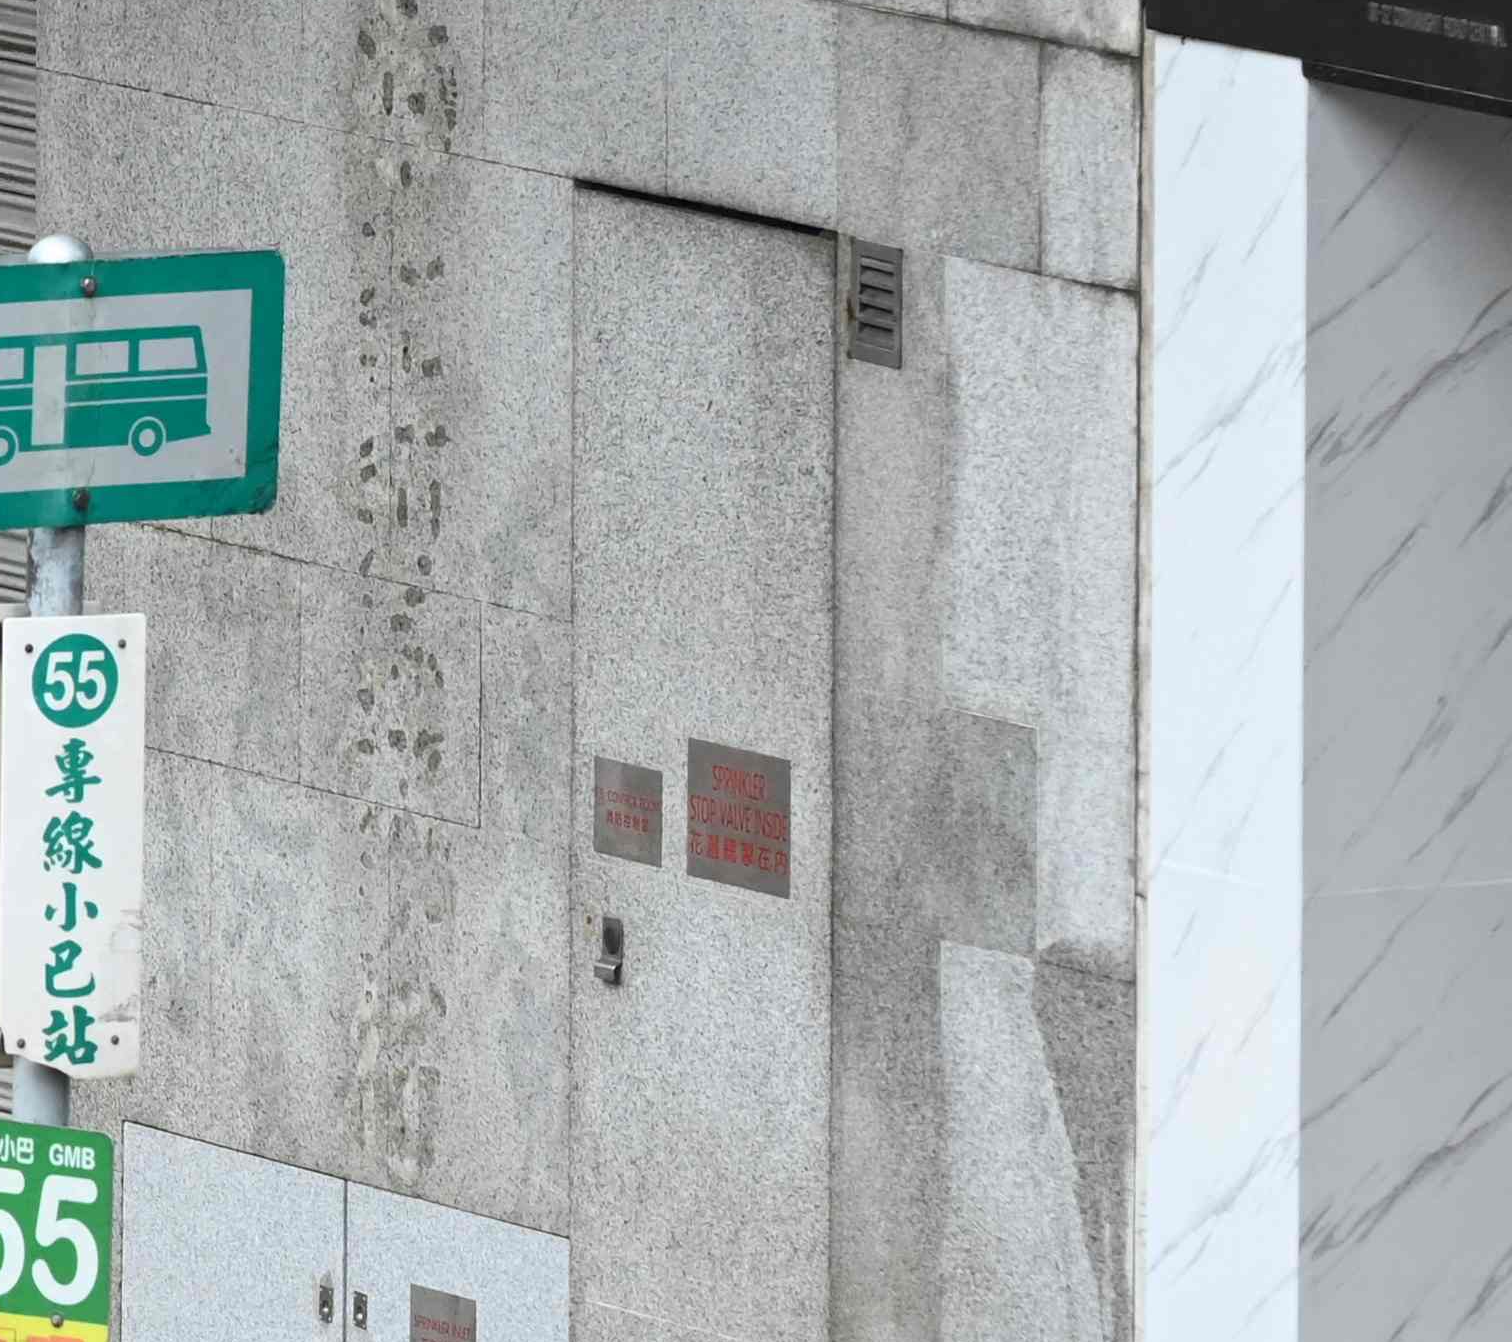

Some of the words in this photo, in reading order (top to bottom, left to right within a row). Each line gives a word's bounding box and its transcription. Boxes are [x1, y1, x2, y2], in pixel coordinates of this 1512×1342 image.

[43, 649, 108, 712] 55
[690, 793, 715, 824] STOP
[720, 804, 752, 834] VALVE
[42, 738, 104, 1067] 專線小巴站
[48, 1143, 96, 1171] GMB
